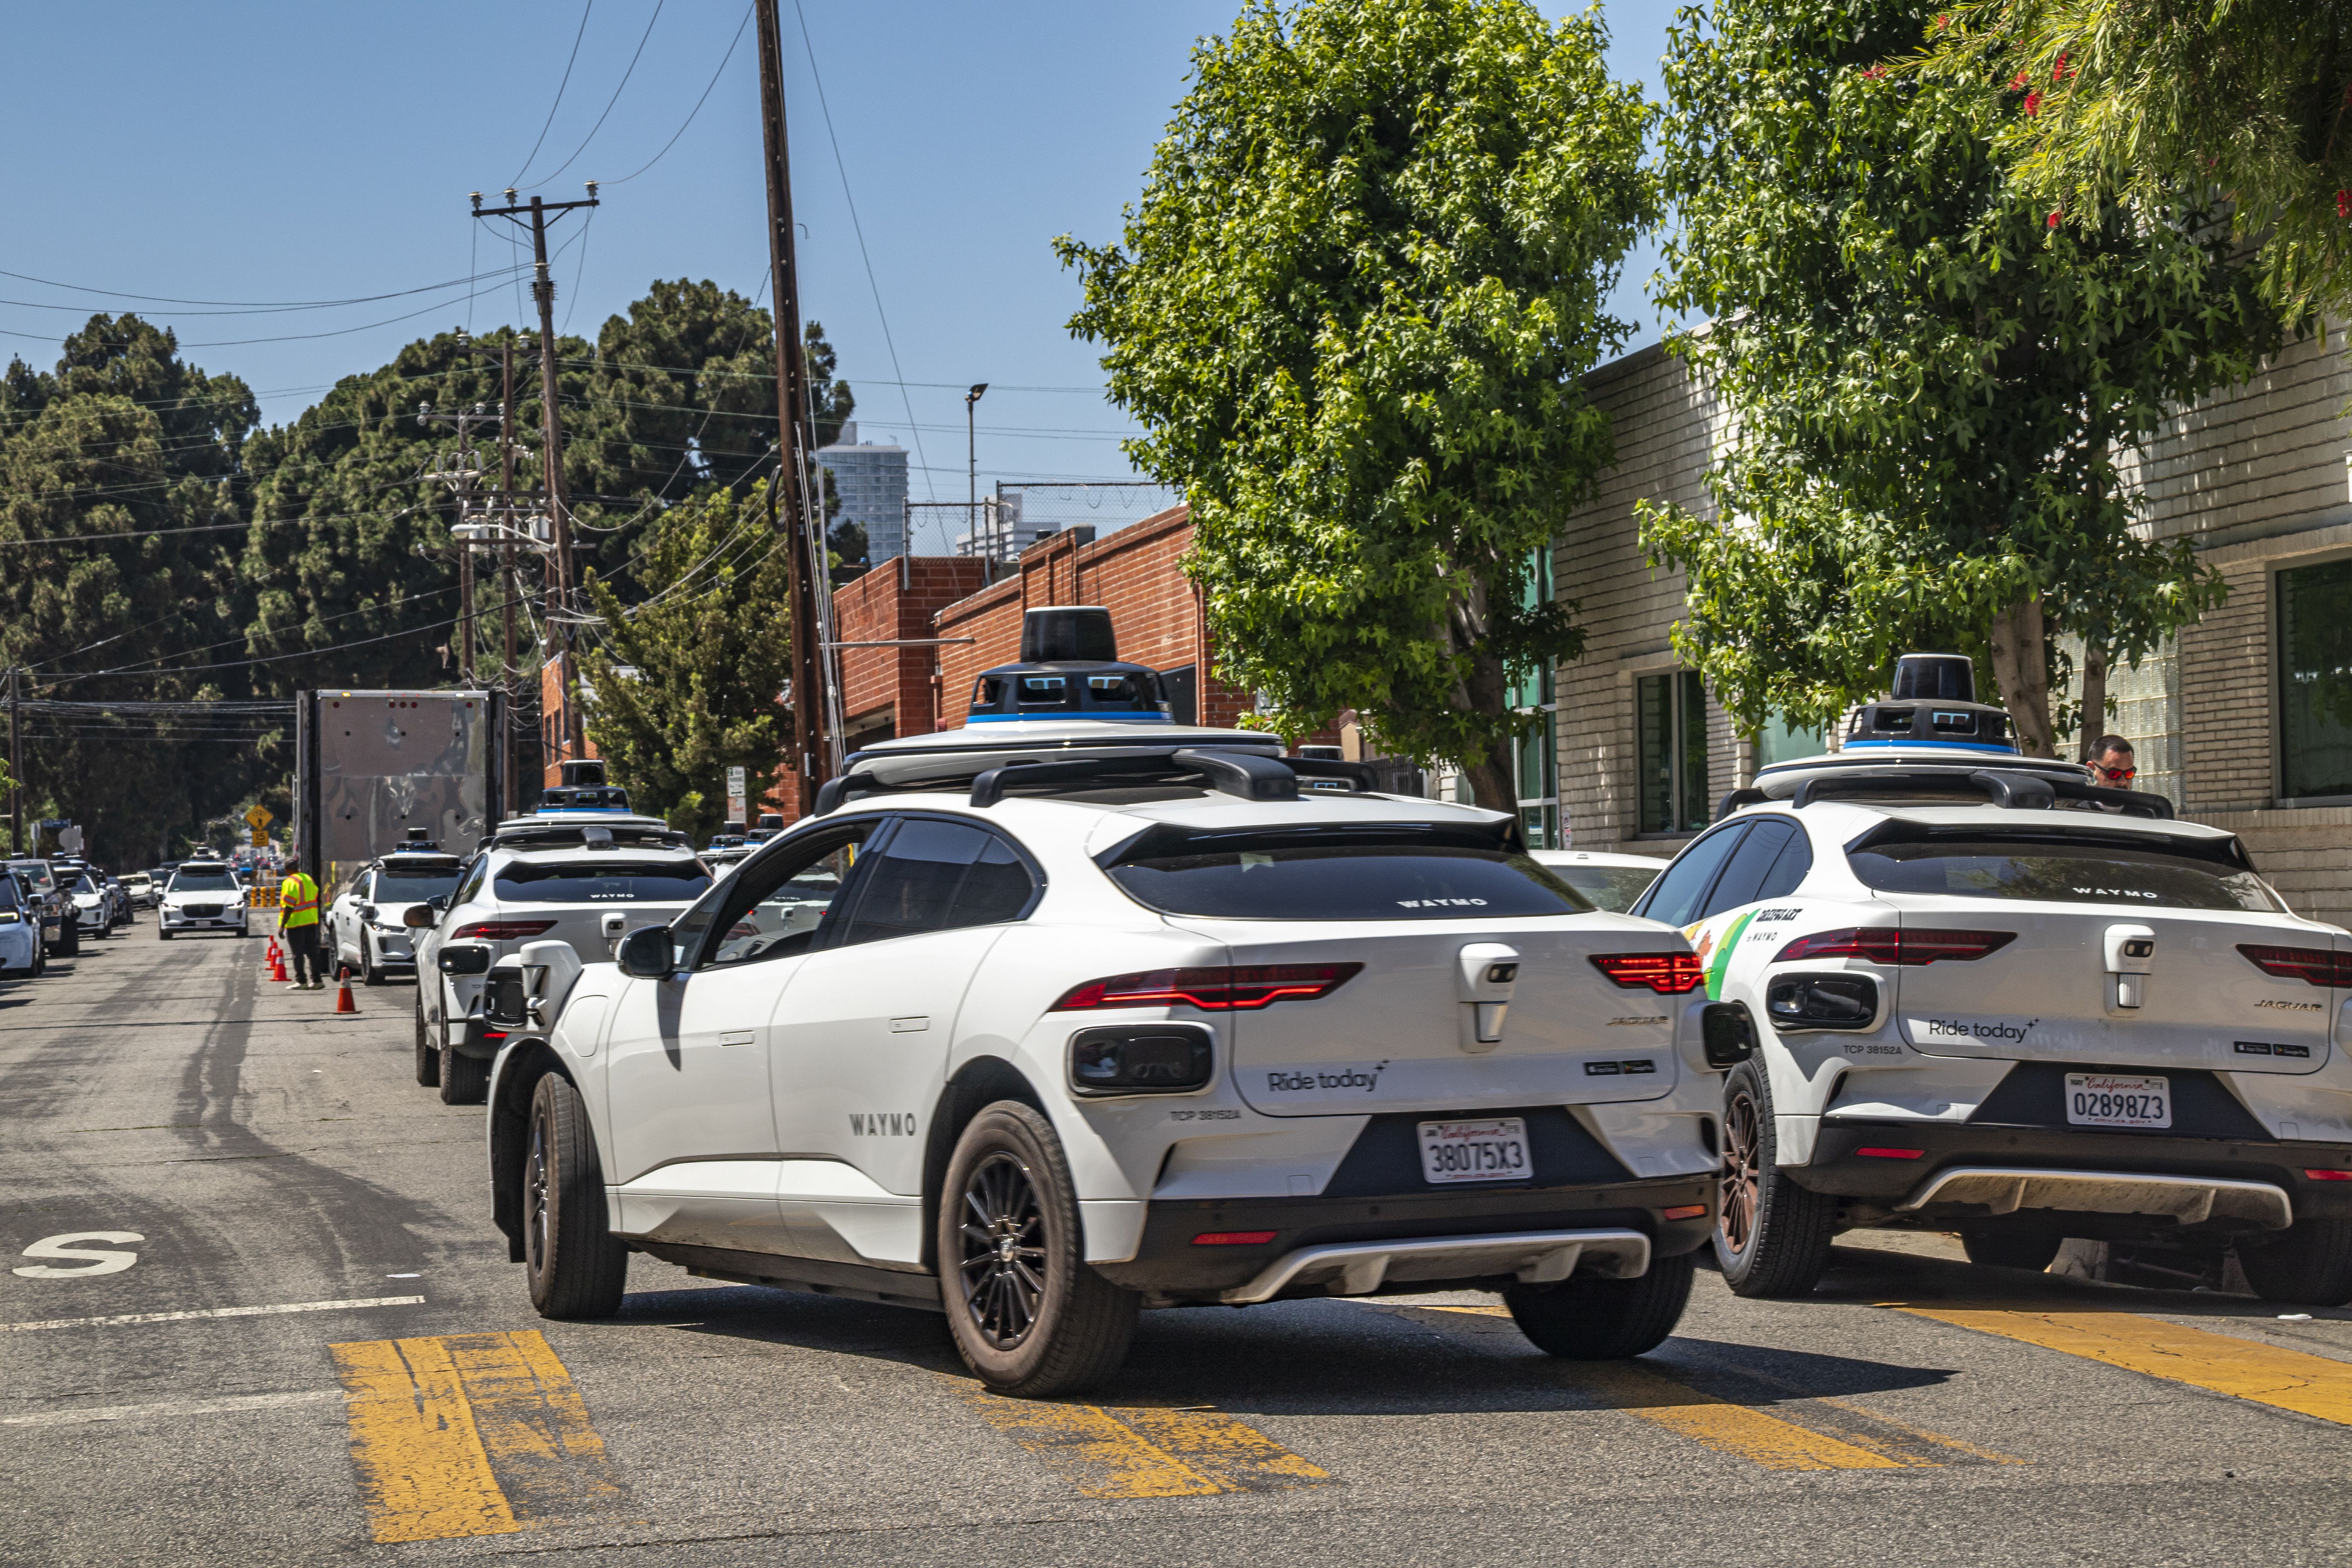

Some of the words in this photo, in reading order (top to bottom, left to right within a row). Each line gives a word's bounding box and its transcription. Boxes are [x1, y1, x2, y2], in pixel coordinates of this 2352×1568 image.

[256, 832, 265, 841] 15
[2072, 887, 2157, 898] WAYMO
[1396, 898, 1488, 908] WAYMO
[1752, 932, 1778, 941] WAYMO
[2254, 1000, 2323, 1012] JAGUAR
[1930, 1019, 1968, 1036] Ride
[1973, 1022, 2027, 1044] today
[1843, 1045, 1864, 1054] TCP
[1866, 1045, 1903, 1054] 38152A
[1267, 1071, 1315, 1092] Ride
[1317, 1068, 1378, 1092] today
[2087, 1077, 2150, 1093] California
[2074, 1092, 2164, 1119] 02898Z3
[1169, 1111, 1196, 1121] TCP
[848, 1112, 916, 1136] WAYMO
[1429, 1142, 1524, 1172] 38075X3
[12, 1231, 145, 1278] S
